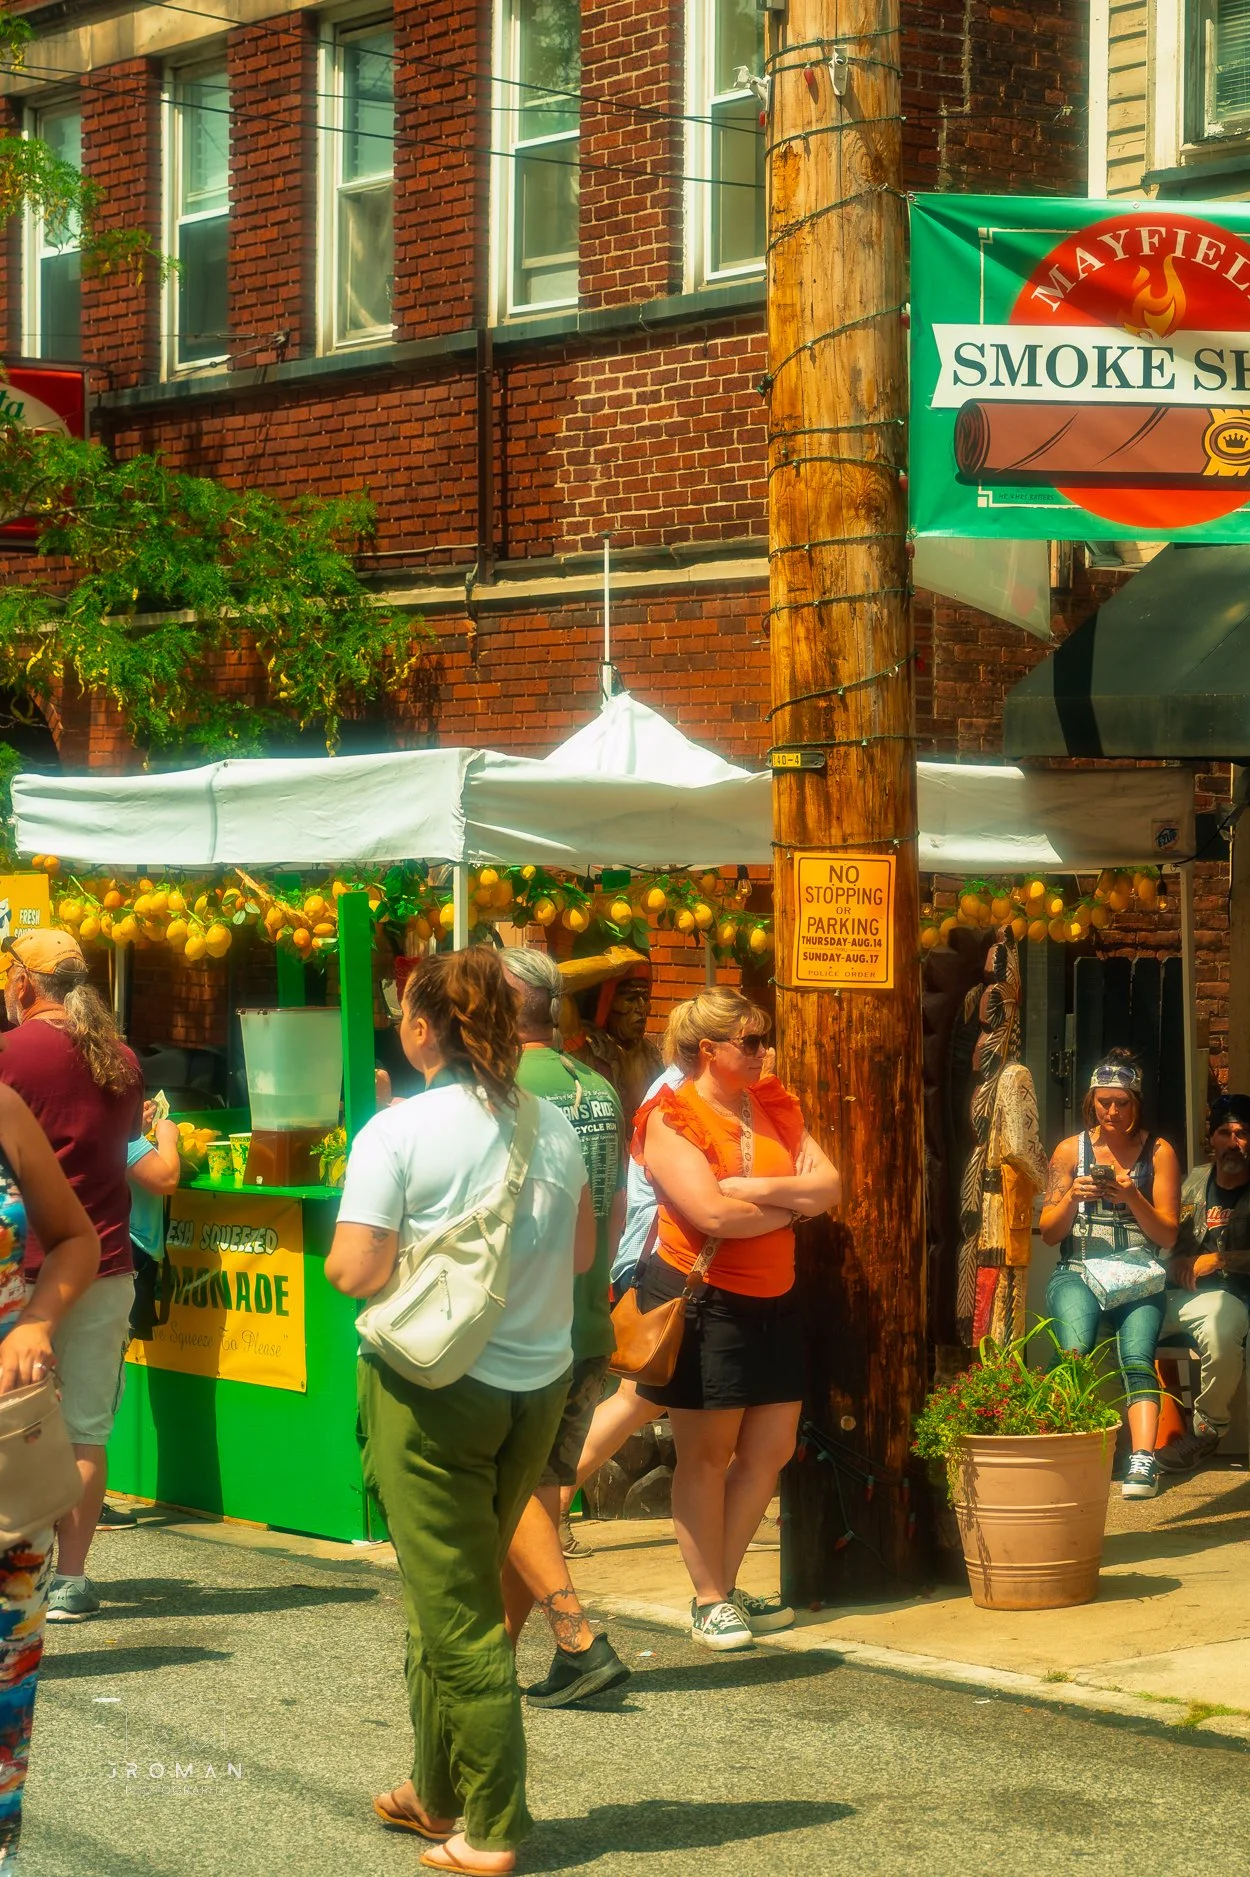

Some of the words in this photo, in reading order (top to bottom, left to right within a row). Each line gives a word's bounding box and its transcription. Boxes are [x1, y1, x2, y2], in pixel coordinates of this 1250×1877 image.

[952, 342, 1176, 391] SMOKE
[829, 864, 860, 885] NO
[805, 885, 883, 906] STOPPING
[20, 908, 41, 926] FRESH
[836, 906, 851, 915] OR
[807, 916, 880, 937] PARKING
[808, 970, 840, 978] POLICE
[844, 970, 876, 979] ORDER
[200, 1223, 279, 1256] SQUEEZED
[169, 1264, 290, 1317] MONADE
